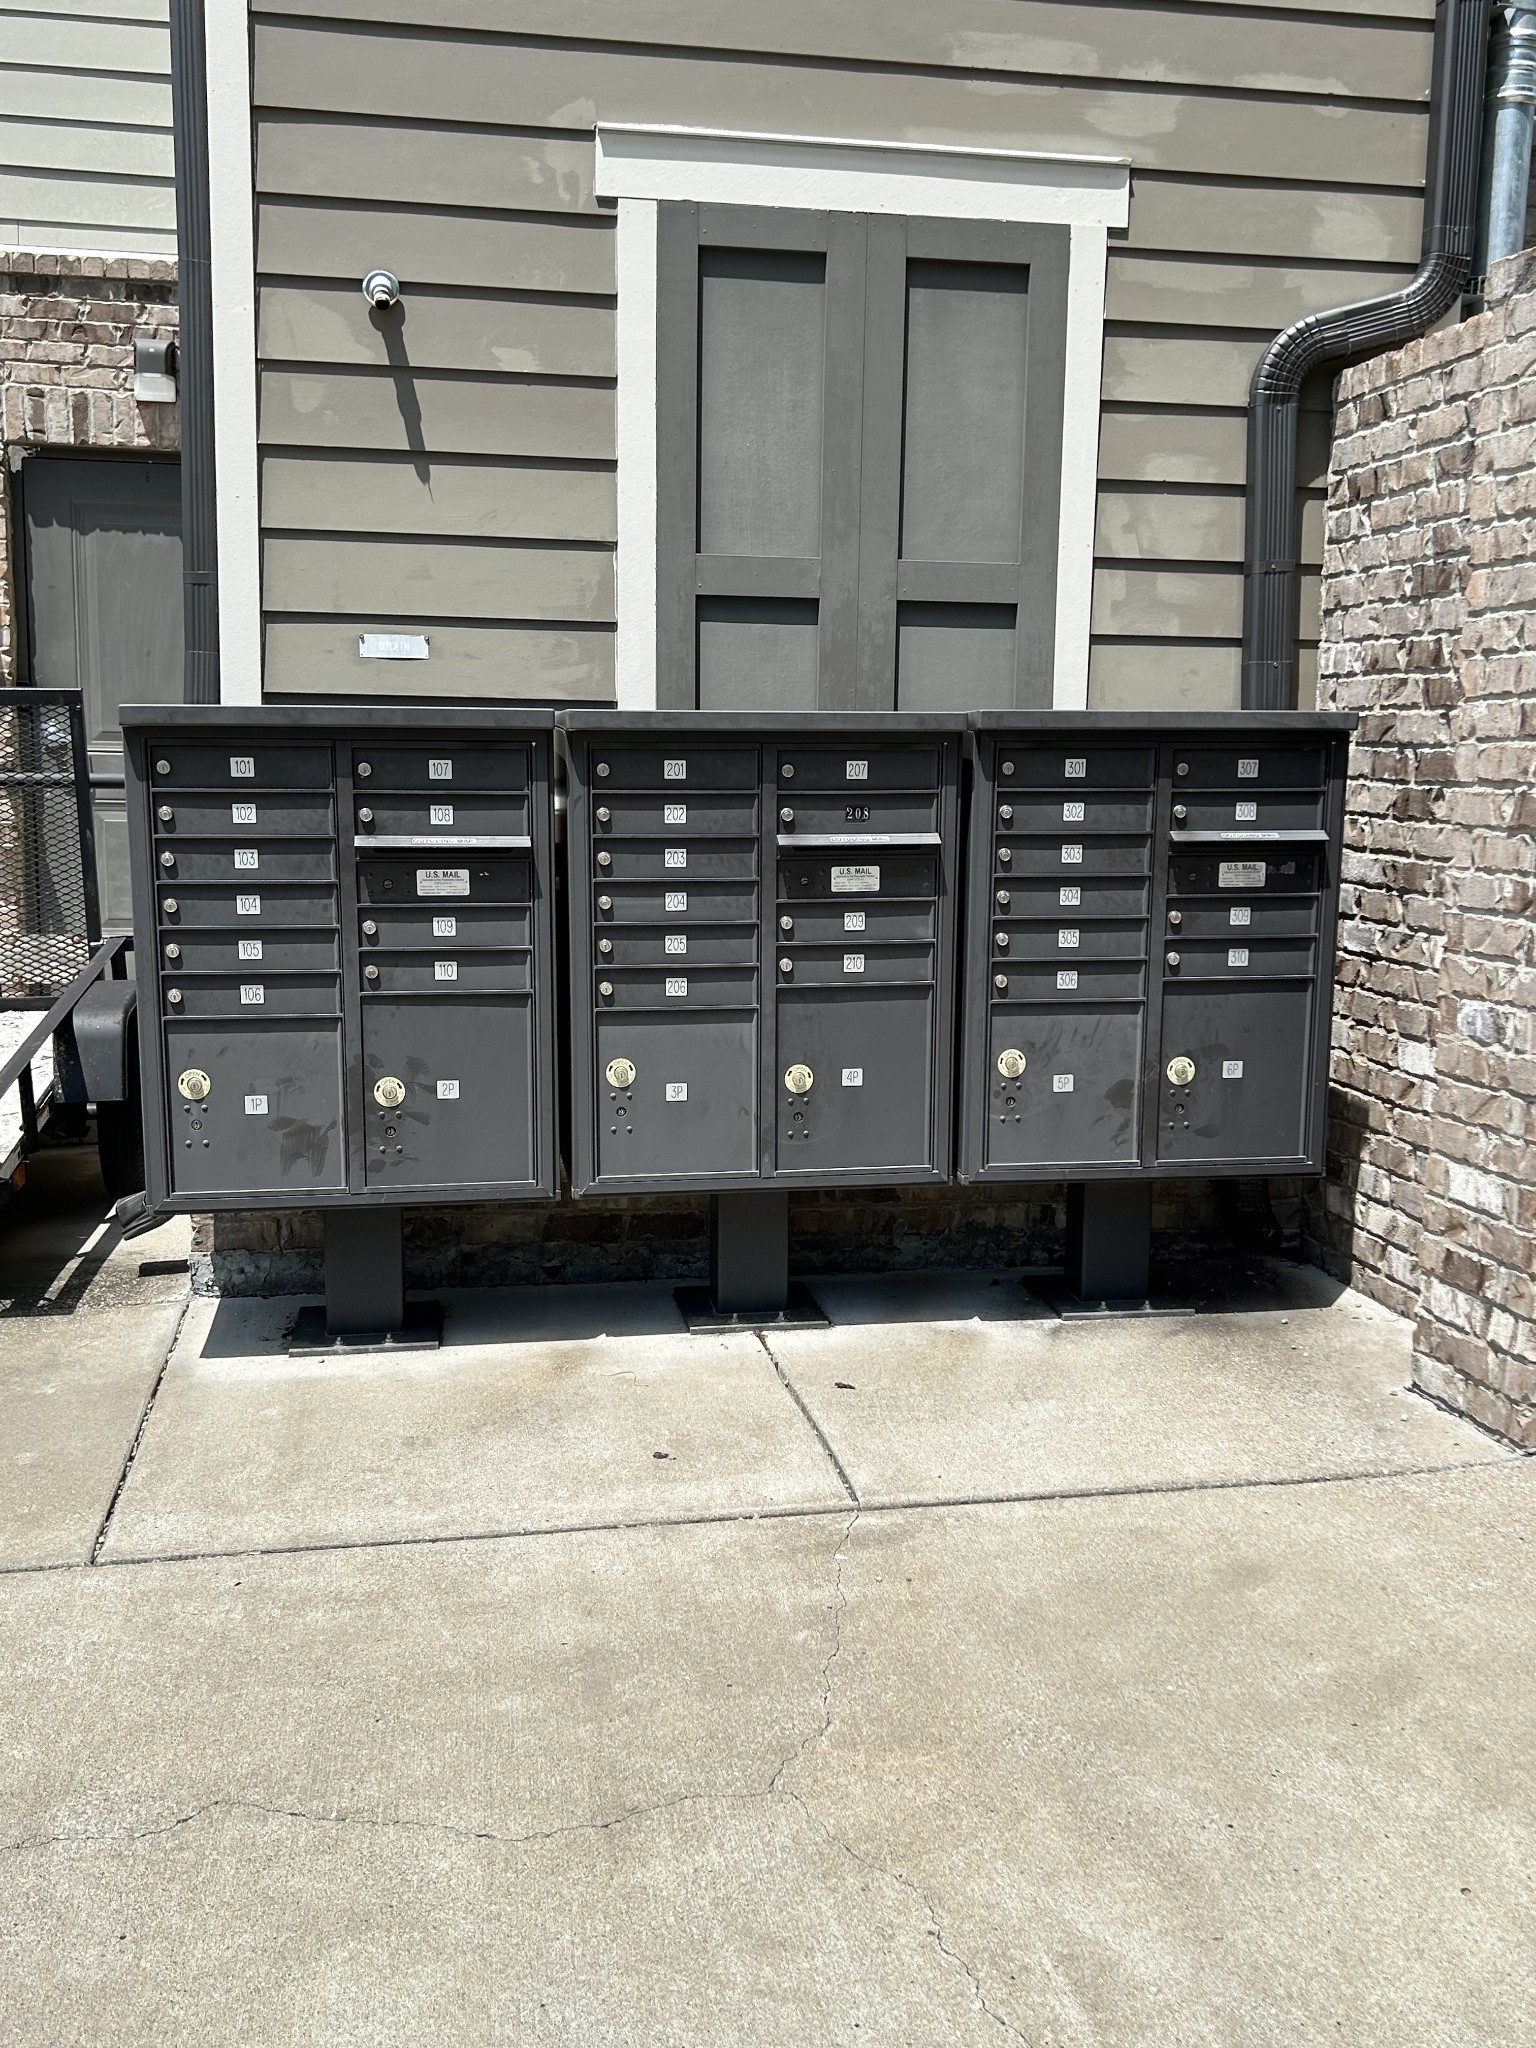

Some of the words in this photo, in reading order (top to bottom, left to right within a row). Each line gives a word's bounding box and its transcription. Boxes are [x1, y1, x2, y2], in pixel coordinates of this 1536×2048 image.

[377, 641, 411, 651] DRAIN
[234, 760, 251, 775] 101
[432, 762, 449, 777] 107
[666, 762, 684, 777] 201
[848, 763, 866, 777] 207
[1067, 761, 1084, 775] 301
[1240, 762, 1257, 775] 307
[235, 806, 253, 821] 102
[433, 808, 451, 822] 108
[667, 807, 684, 821] 202
[846, 807, 869, 821] 208
[1065, 805, 1082, 819] 302
[1238, 805, 1254, 818] 308
[238, 852, 256, 866] 103
[667, 851, 684, 865] 203
[1064, 847, 1080, 861] 303
[839, 867, 853, 875] U.S.
[667, 895, 685, 909] 204
[1062, 889, 1078, 903] 304
[240, 898, 257, 912] 104
[846, 914, 863, 928] 209
[1232, 909, 1248, 923] 309
[436, 920, 454, 934] 109
[667, 937, 684, 951] 205
[1060, 932, 1077, 945] 305
[241, 943, 260, 957] 105
[846, 956, 862, 970] 210
[1230, 951, 1247, 964] 310
[438, 964, 454, 978] 110
[668, 980, 685, 994] 206
[1059, 973, 1075, 987] 306
[244, 987, 262, 1002] 106
[613, 1059, 628, 1067] OPEN
[1226, 1063, 1239, 1076] 6P
[184, 1071, 200, 1079] OPEN
[381, 1078, 396, 1086] OPEN
[846, 1070, 859, 1083] 4P
[442, 1082, 455, 1097] 2P
[1057, 1076, 1070, 1090] 5P
[670, 1085, 683, 1099] 3P
[250, 1098, 263, 1111] 1P
